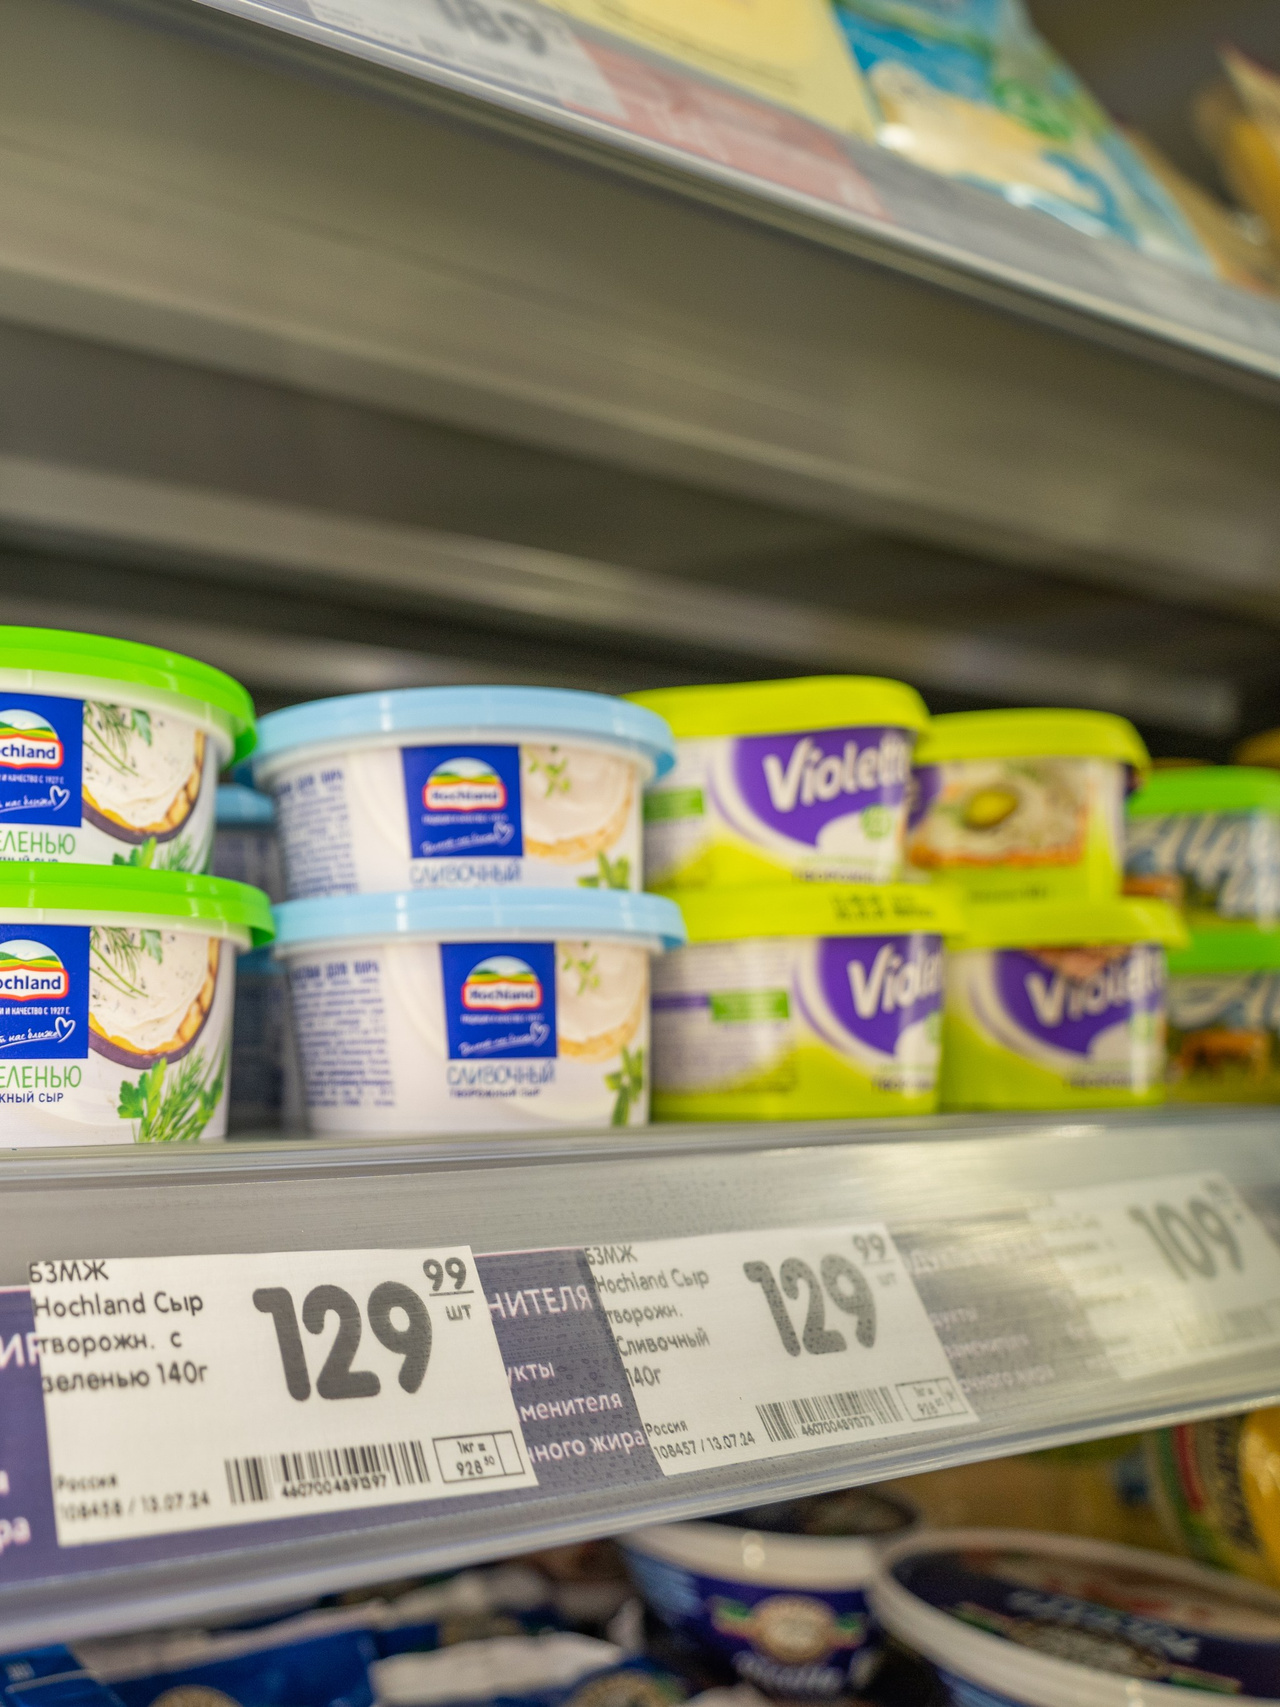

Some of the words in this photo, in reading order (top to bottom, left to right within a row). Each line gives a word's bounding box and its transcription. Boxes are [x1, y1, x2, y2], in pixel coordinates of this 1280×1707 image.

[39, 1093, 64, 1103] СЫР
[1128, 1196, 1243, 1282] 109
[29, 1261, 109, 1284] БЗМЖ
[594, 1268, 669, 1295] Hochland
[671, 1267, 710, 1290] Сыр
[34, 1292, 146, 1318] Hochland
[154, 1290, 204, 1316] Сыр
[488, 1284, 593, 1320] НИТЕЛЯ
[743, 1254, 876, 1357] 129
[852, 1233, 887, 1261] 99
[446, 1304, 472, 1321] шт
[606, 1304, 683, 1327] творожн.
[252, 1281, 432, 1402] 129
[422, 1257, 467, 1291] 99
[615, 1327, 710, 1356] Сливочный
[39, 1333, 155, 1358] творожн.
[170, 1331, 183, 1348] с
[42, 1369, 150, 1394] зеленью
[157, 1359, 208, 1386] 140г
[519, 1392, 624, 1424] менителя
[588, 1429, 646, 1456] жира
[644, 1419, 689, 1438] Россия
[456, 1460, 483, 1477] 928
